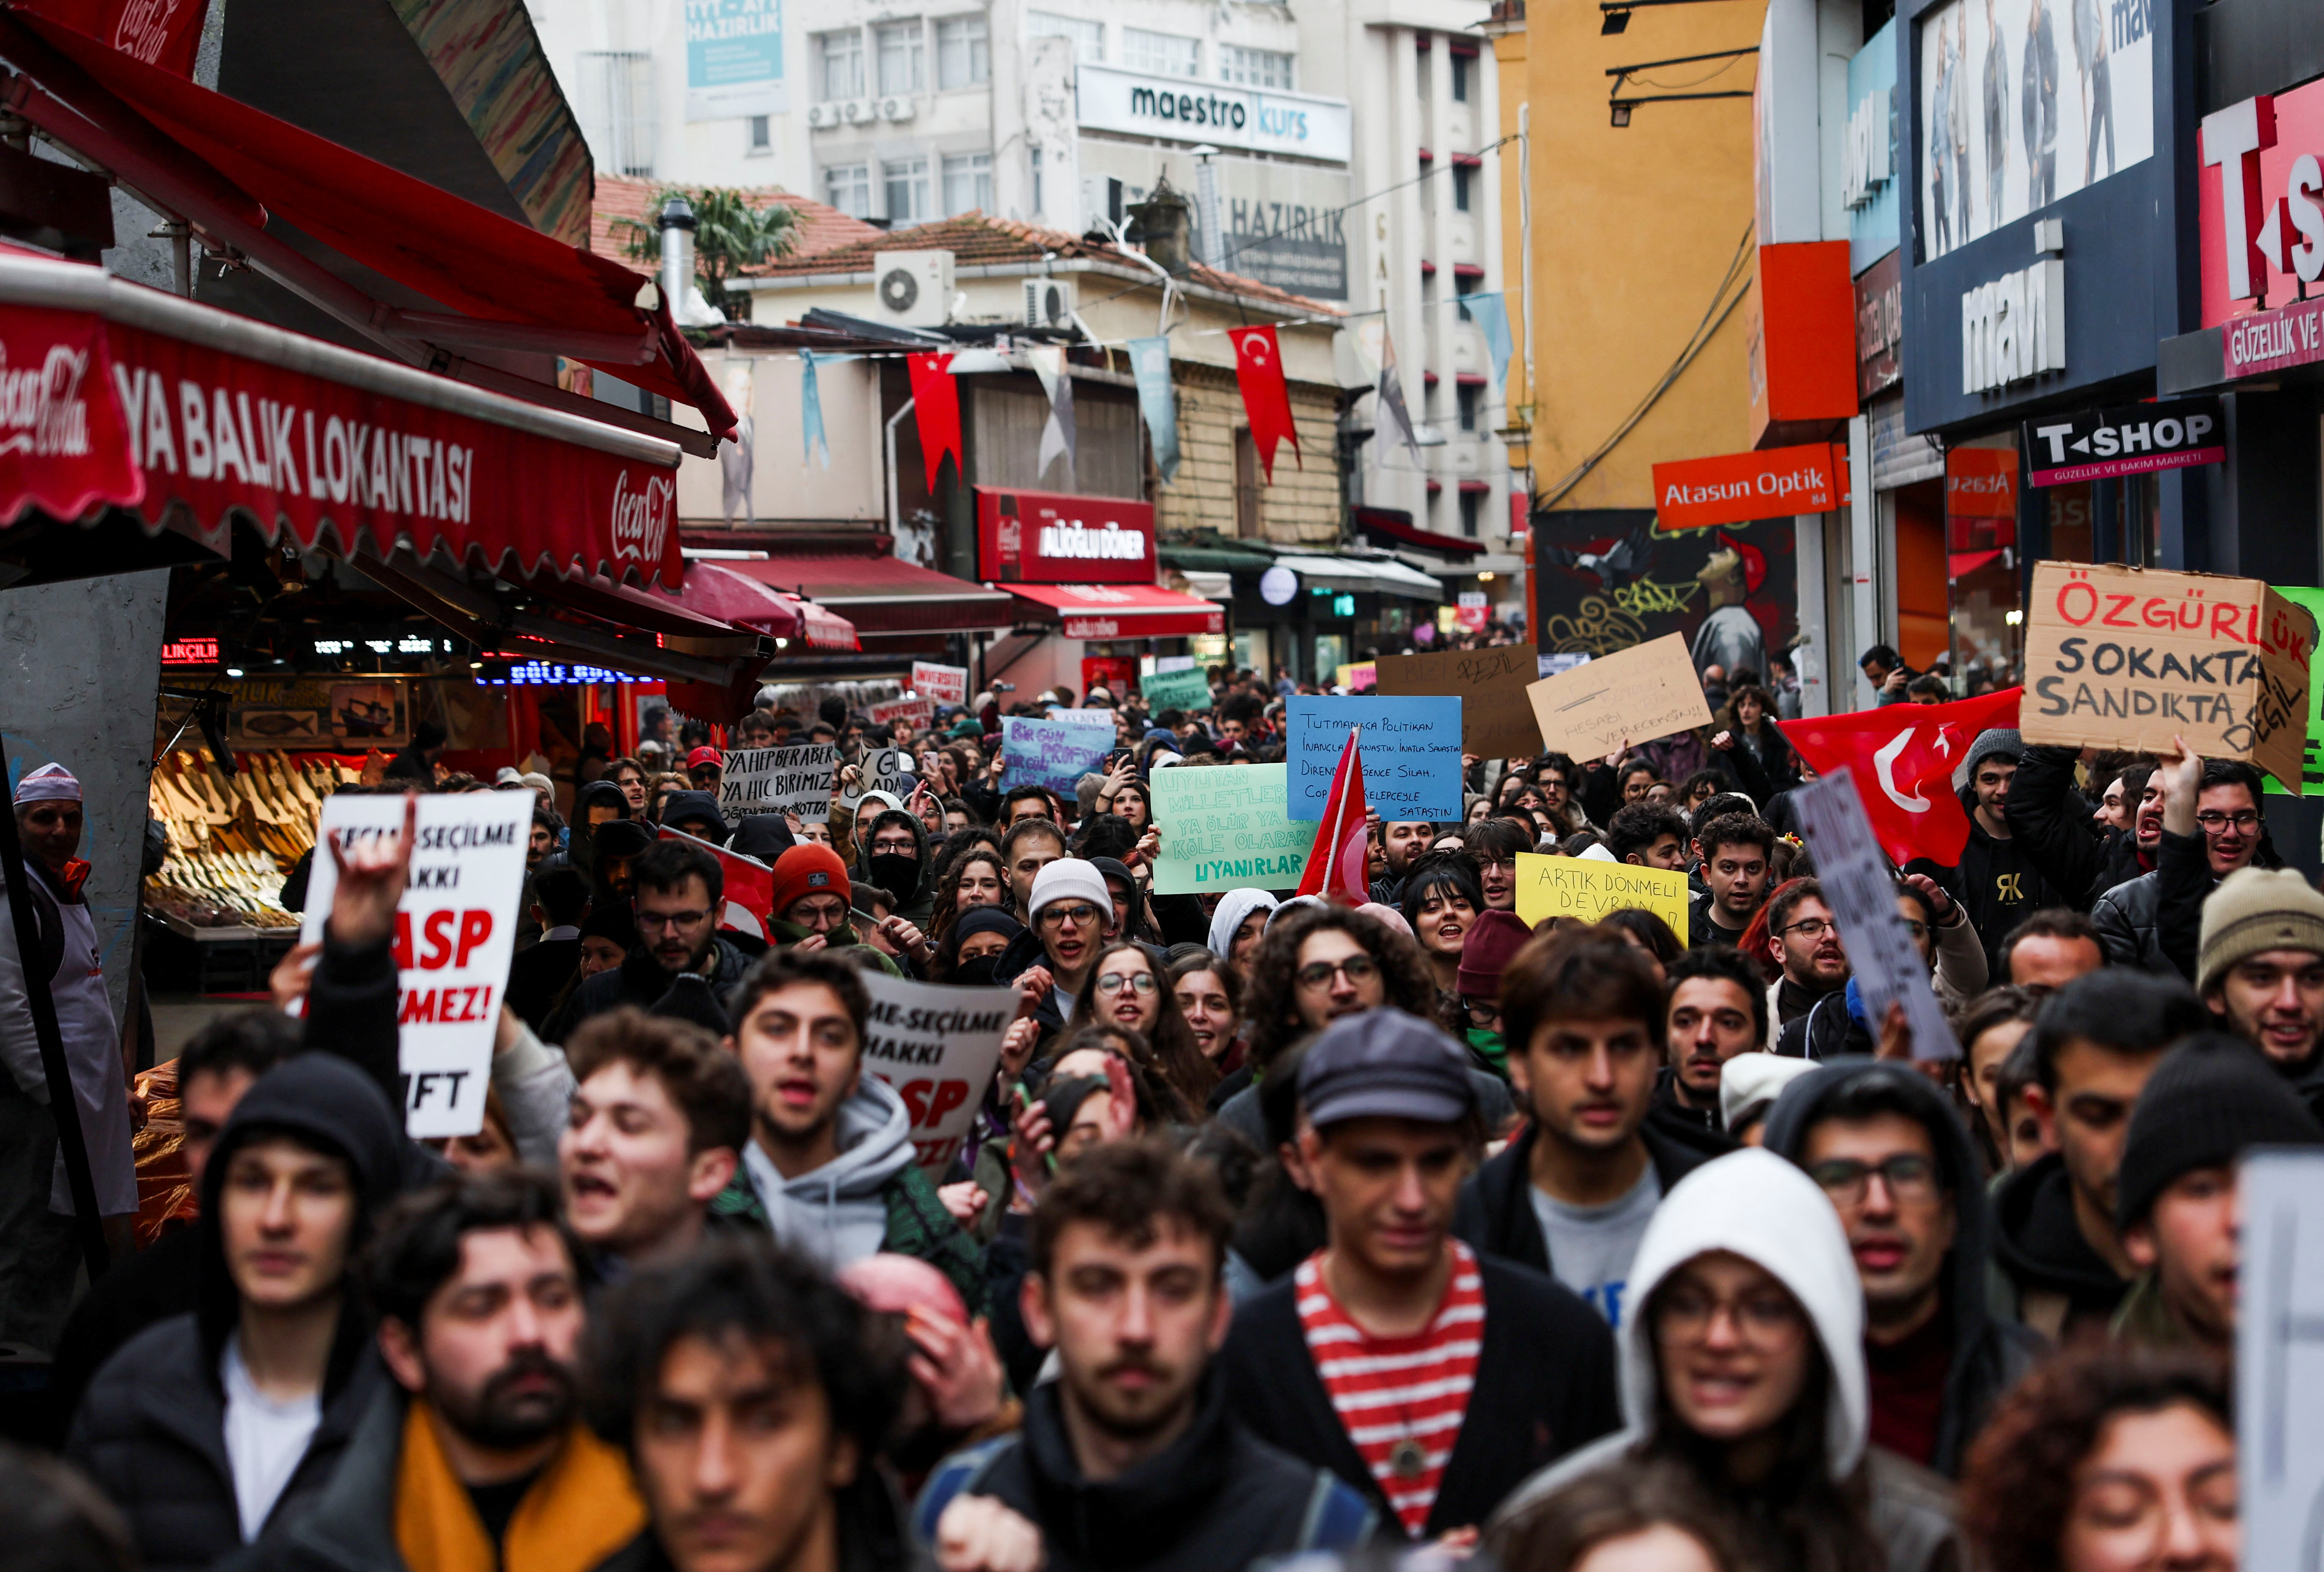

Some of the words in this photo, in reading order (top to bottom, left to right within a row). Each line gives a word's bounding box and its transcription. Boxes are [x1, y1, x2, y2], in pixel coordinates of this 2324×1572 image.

[687, 12, 780, 41] HAZIRLIK
[1131, 86, 1246, 130] maestro
[1258, 95, 1309, 140] kurs
[1231, 197, 1345, 245] HAZIRLIK
[1962, 218, 2065, 395] mavi
[2231, 311, 2296, 366] GÜZELLİK
[2298, 312, 2319, 351] VE
[178, 379, 302, 496] BALIK
[302, 408, 474, 526] LOKANTASI
[2054, 463, 2101, 481] GÜZELLİK
[2104, 463, 2117, 474] VE
[2120, 459, 2154, 472] BAKIM
[2156, 452, 2202, 466] MARKETİ
[1664, 480, 1751, 507] Atasun
[1757, 467, 1825, 498] Optik
[1811, 492, 1827, 505] 84
[2057, 570, 2310, 672] ÖZGÜRLÜK
[2056, 637, 2272, 694] SOKAKTA
[2036, 676, 2236, 724] SANDIKTA
[1011, 721, 1034, 742] BİR
[1037, 728, 1065, 743] GÜN
[1381, 717, 1434, 732] POLİTİKAN
[1565, 712, 1622, 738] HESABI
[1399, 738, 1425, 753] İNATLA
[725, 752, 747, 774] YA
[748, 750, 775, 773] HEP
[722, 781, 742, 802] YA
[747, 778, 772, 800] HİÇ
[775, 772, 833, 796] BİRİMİZ
[1159, 769, 1248, 792] UYUYAN
[1305, 785, 1327, 799] COP
[779, 801, 827, 816] BOYKOTTA
[1168, 784, 1287, 813] MİLLETLER
[1399, 806, 1452, 818] SATAŞTIN
[1177, 819, 1201, 836] YA
[1207, 813, 1249, 831] ÖLÜR
[1256, 811, 1282, 827] YA
[1172, 834, 1224, 860] KÖLE
[1235, 830, 1308, 850] OLARAK
[1195, 853, 1303, 882] UYANIRLAR
[1538, 867, 1597, 891] ARTIK
[1605, 872, 1678, 898] DÖNMELİ
